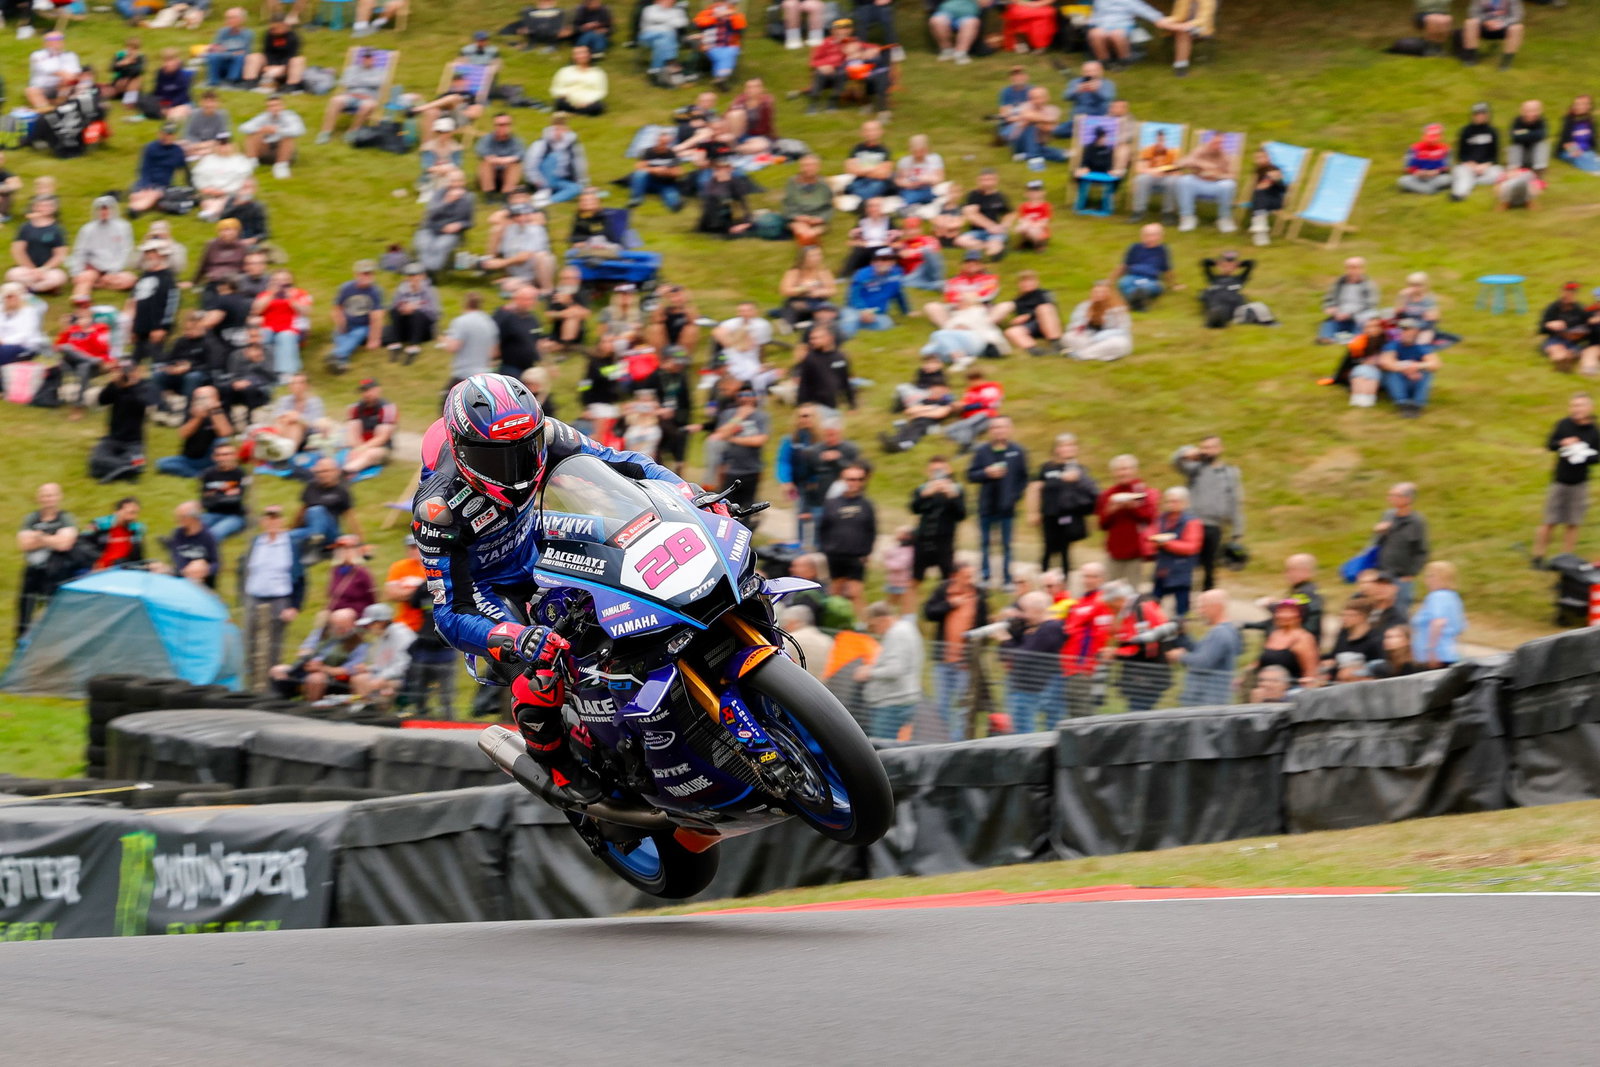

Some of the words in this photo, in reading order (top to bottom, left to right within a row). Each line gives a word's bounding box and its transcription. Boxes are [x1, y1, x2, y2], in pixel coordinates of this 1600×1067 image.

[491, 416, 530, 432] LS2
[729, 529, 750, 562] YAMAHA
[544, 547, 607, 569] RACEWAYS
[634, 527, 707, 590] 28
[601, 601, 631, 618] YAMALUBE
[610, 614, 659, 637] YAMAHA
[731, 700, 760, 737] PIRELLI
[760, 751, 777, 763] sbs
